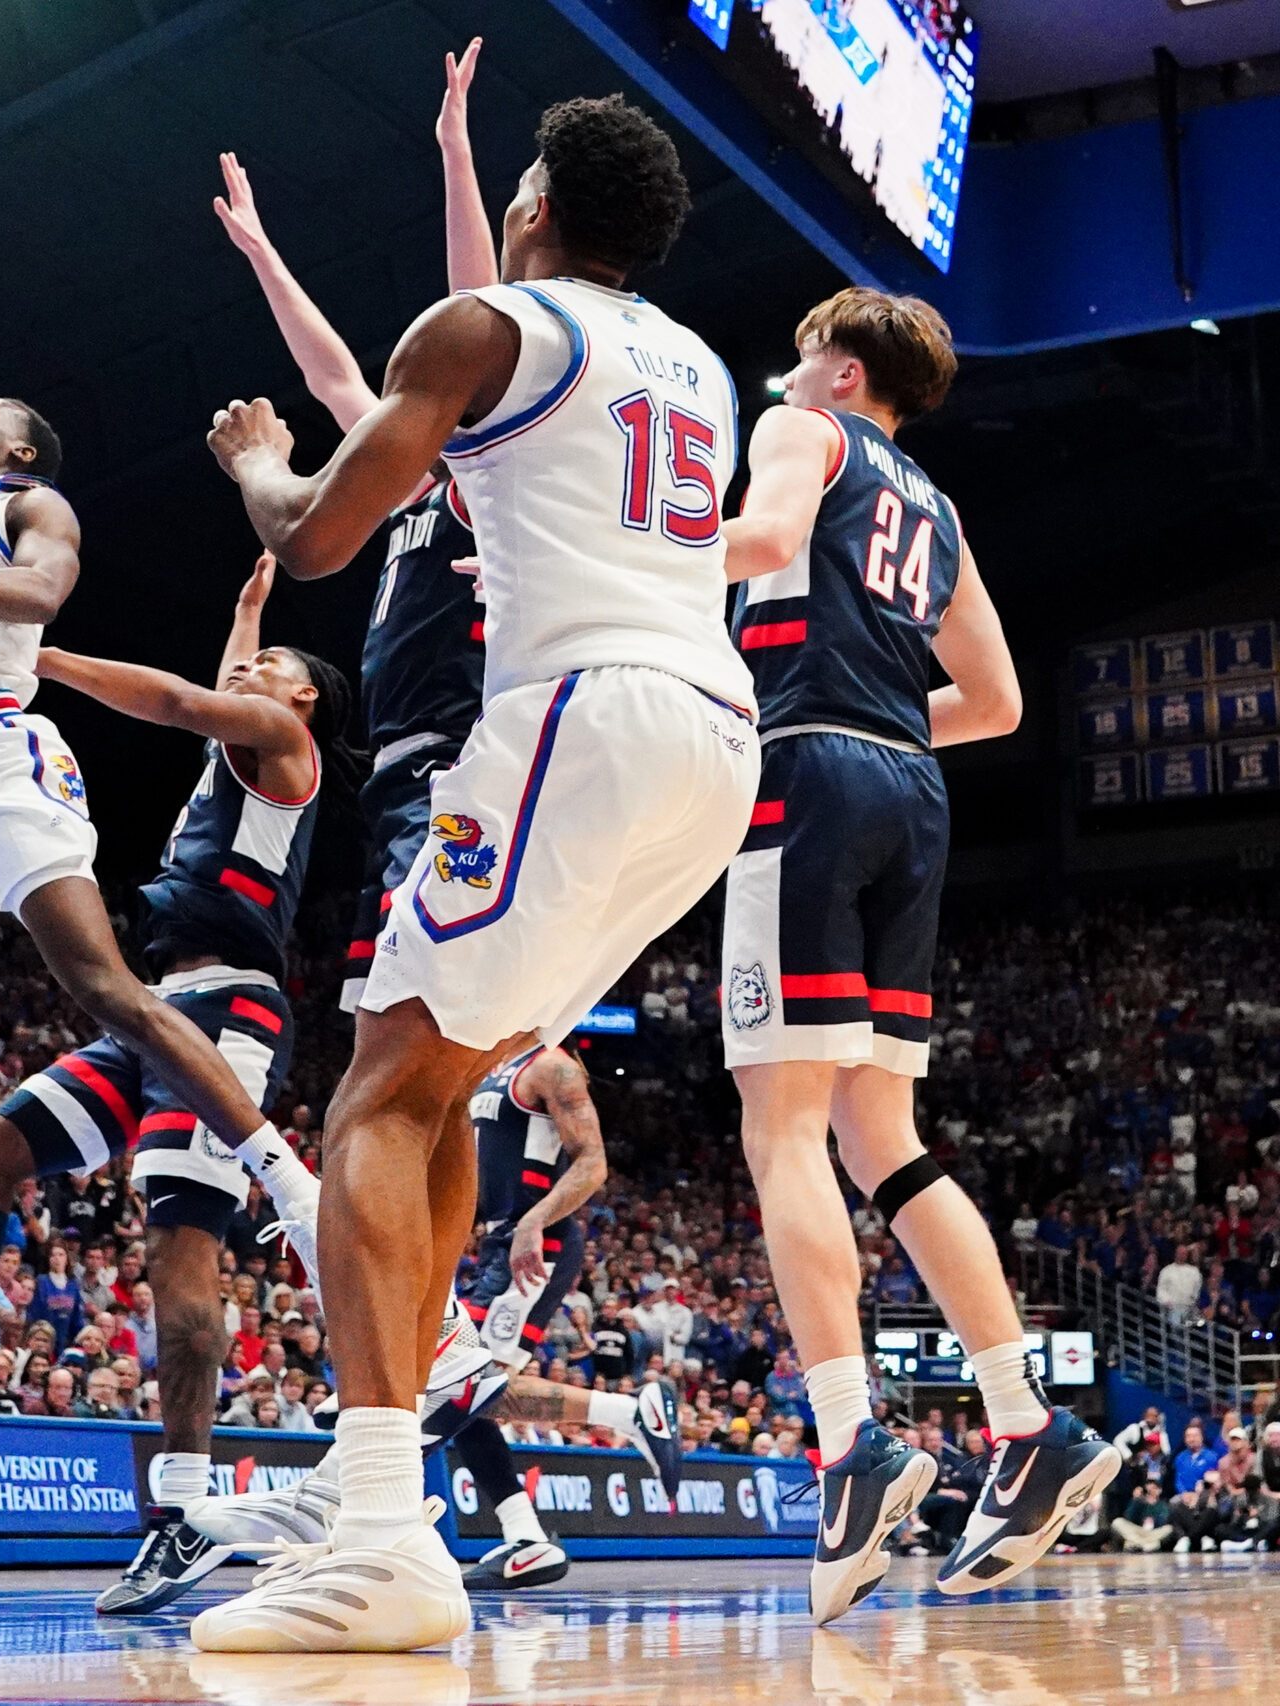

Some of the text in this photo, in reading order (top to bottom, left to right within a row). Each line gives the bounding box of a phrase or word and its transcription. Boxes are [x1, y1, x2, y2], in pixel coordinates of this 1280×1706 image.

[624, 346, 699, 396] TILLER
[608, 388, 721, 548] 15
[862, 435, 940, 517] MULLINS
[864, 486, 934, 623] 24
[458, 851, 479, 866] KU
[72, 1456, 98, 1483] OF
[452, 1466, 479, 1515] G
[70, 1484, 137, 1513] SYSTEM
[607, 1472, 630, 1517] G
[737, 1478, 758, 1519] G
